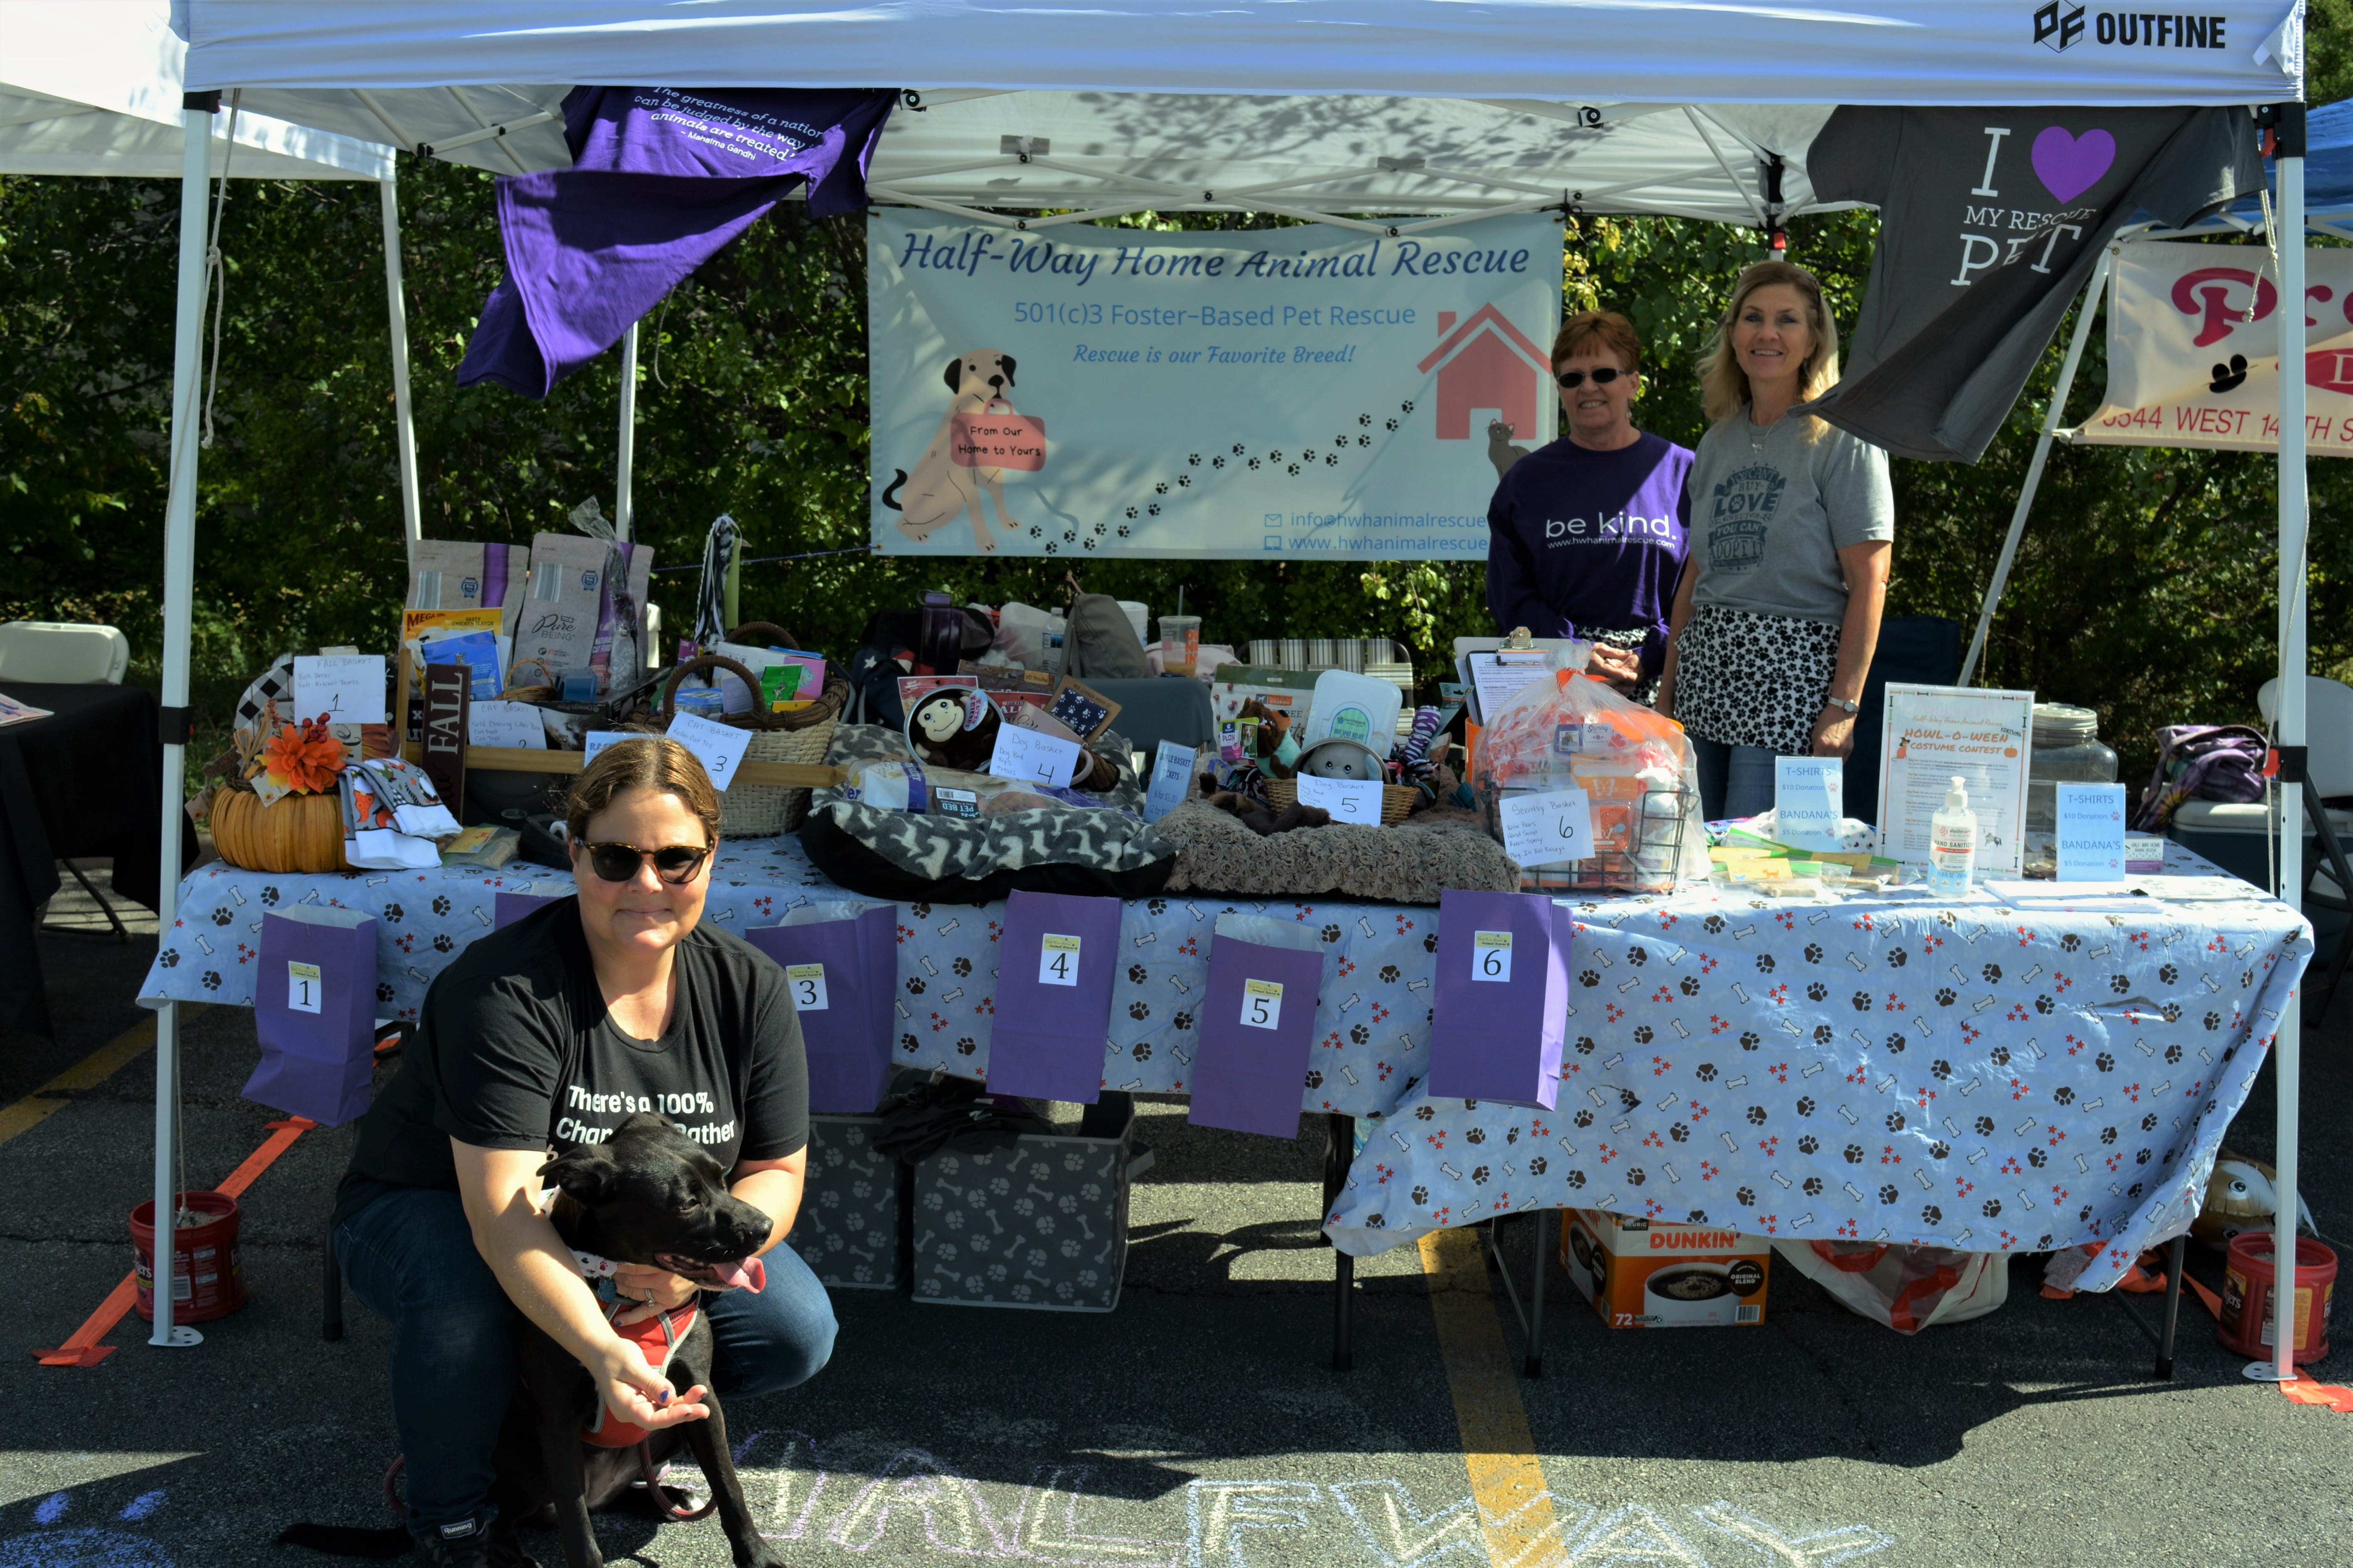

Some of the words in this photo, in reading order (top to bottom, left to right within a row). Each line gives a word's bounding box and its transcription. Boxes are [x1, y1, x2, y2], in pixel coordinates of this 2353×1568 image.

[2096, 12, 2226, 49] OUTFINE
[680, 95, 749, 116] greatness
[634, 96, 659, 106] can
[662, 98, 680, 110] be
[678, 106, 732, 125] judged
[732, 118, 749, 130] by
[751, 126, 774, 138] the
[777, 133, 805, 150] way
[651, 113, 708, 131] animals
[710, 127, 734, 138] are
[687, 131, 725, 149] Mahatma
[727, 144, 756, 160] Gandhi
[1971, 127, 2011, 198] I
[1964, 205, 1999, 228] MY
[2009, 207, 2097, 231] RESCUE
[899, 232, 1099, 286] Half-Way
[1111, 247, 1225, 277] Home
[1235, 240, 1380, 278] Animal
[1391, 241, 1530, 276] Rescue
[1951, 223, 2081, 287] PET
[1014, 302, 1103, 325] 501(c)3
[1112, 305, 1274, 326] Foster-Based
[1284, 306, 1322, 326] Pet
[1330, 305, 1416, 325] Rescue
[1072, 345, 1139, 363] Rescue
[1146, 346, 1162, 363] is
[1169, 350, 1201, 363] our
[1207, 345, 1286, 364] Favorite
[1293, 345, 1357, 364] Breed!
[970, 426, 998, 436] From
[1003, 427, 1023, 436] Our
[2177, 406, 2250, 435] WEST
[2262, 414, 2339, 441] 14TH
[958, 444, 988, 455] Home
[994, 446, 1005, 455] to
[1010, 446, 1041, 457] Yours
[1713, 492, 1779, 519] LOVE
[1546, 517, 1586, 539] be
[1599, 512, 1678, 541] kind.
[1717, 524, 1738, 537] YOU
[1739, 522, 1760, 532] CAN
[1547, 536, 1675, 549] www.hwhanimalrescue.com
[1709, 540, 1748, 559] ADOPT
[1752, 540, 1764, 556] IT
[407, 613, 435, 632] MEGA
[532, 614, 576, 633] Pure
[317, 659, 338, 668] FALL
[328, 694, 345, 712] 1
[481, 704, 496, 713] CAT
[428, 672, 463, 755] FALL
[1912, 715, 1942, 725] Half-Way
[688, 719, 705, 730] CAT
[710, 727, 742, 740] BASKET
[1904, 728, 2008, 743] HOWL-O-WEEN
[2000, 727, 2022, 737] VIRTUAL
[999, 746, 1010, 760] Dog
[1012, 733, 1028, 750] Dog
[1035, 741, 1063, 755] Basket
[1910, 742, 1956, 752] COSTUME
[1959, 745, 2003, 755] CONTEST
[712, 756, 727, 772] 3
[1174, 756, 1191, 767] BASKET
[1037, 763, 1055, 784] 4
[1786, 767, 1831, 776] T-SHIRTS
[1315, 779, 1332, 790] Dog
[1165, 793, 1178, 803] $5.00
[1342, 798, 1360, 812] 5
[1512, 804, 1544, 815] Scentsy
[1549, 800, 1577, 810] Basket
[2067, 795, 2114, 804] T-SHIRTS
[1149, 805, 1154, 813] 12
[1780, 811, 1838, 820] BANDANA'S
[1559, 815, 1574, 838] 6
[2062, 840, 2121, 849] BANDANA'S
[1050, 953, 1069, 979] 4
[1483, 949, 1501, 976] 6
[299, 980, 312, 1006] 1
[799, 980, 817, 1005] 3
[1251, 998, 1270, 1024] 5
[569, 1085, 636, 1113] There's
[638, 1097, 651, 1113] a
[657, 1092, 714, 1114] 100%
[1615, 1313, 1632, 1326] 72
[443, 1522, 473, 1534] Running
